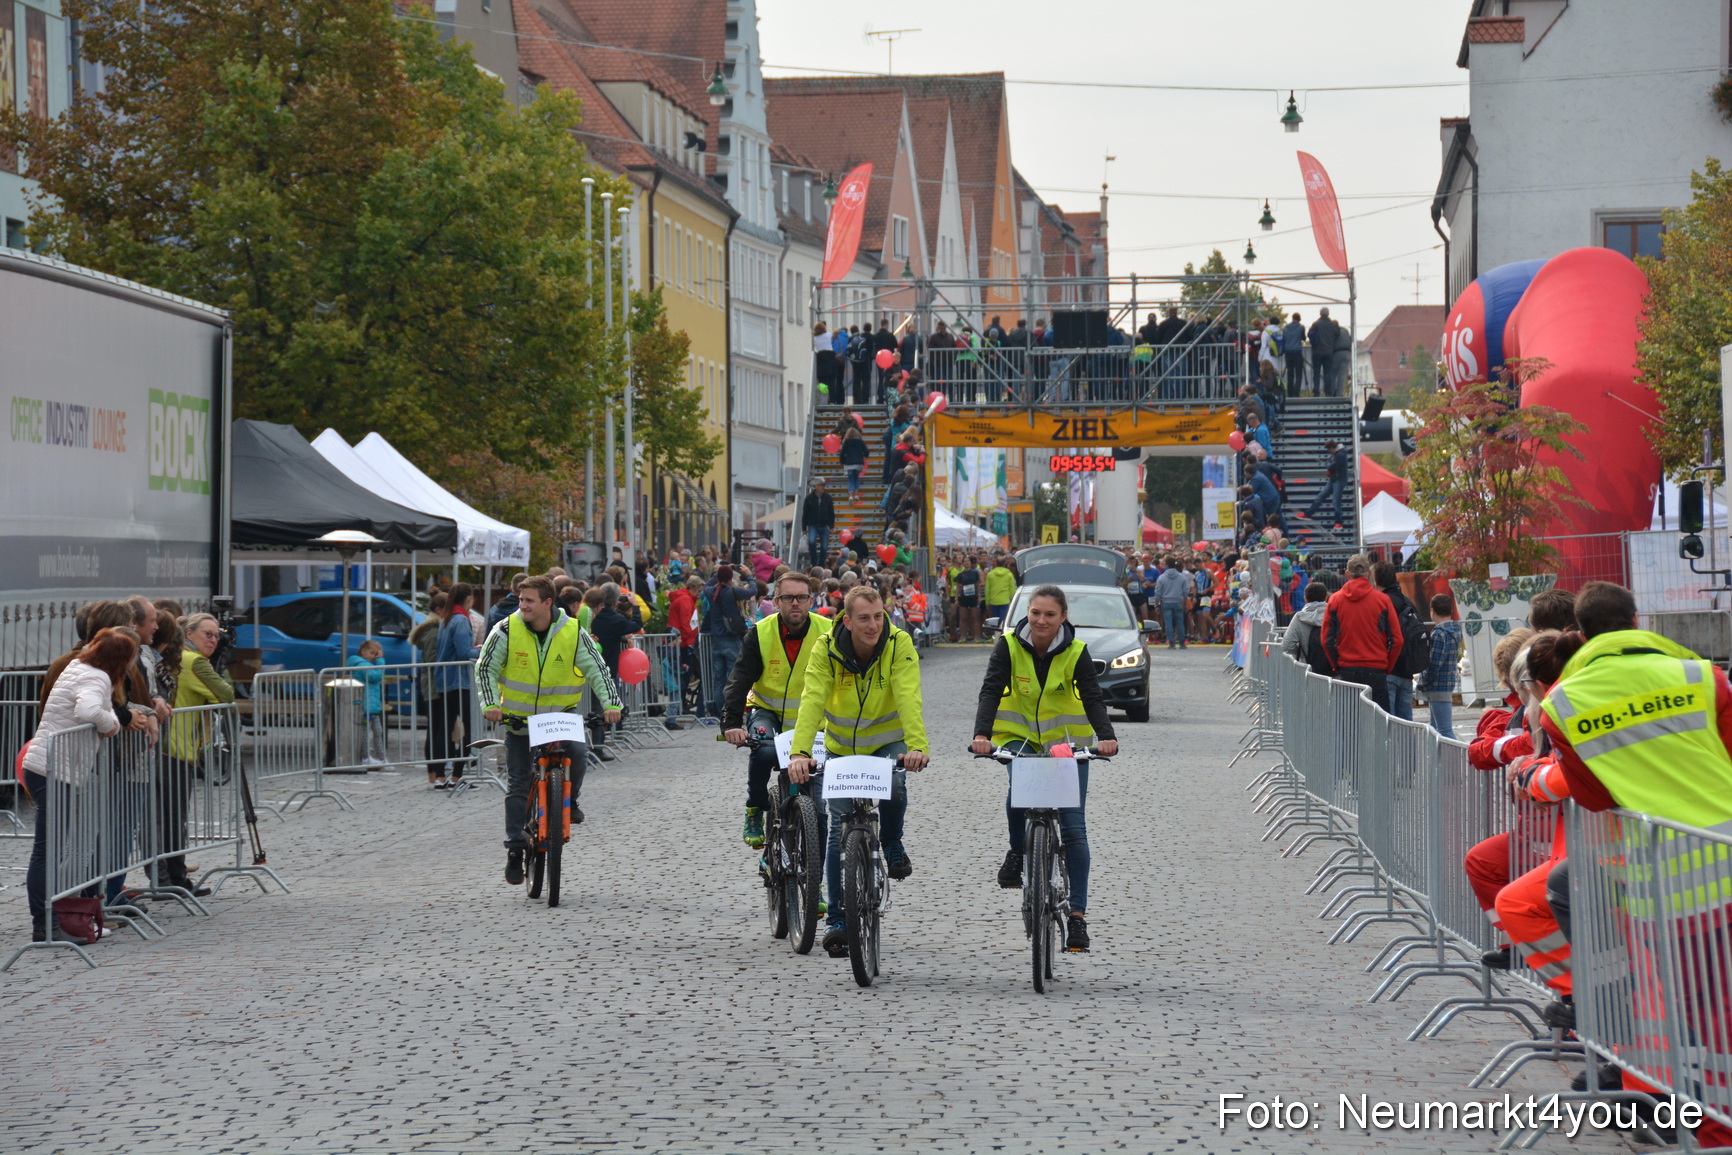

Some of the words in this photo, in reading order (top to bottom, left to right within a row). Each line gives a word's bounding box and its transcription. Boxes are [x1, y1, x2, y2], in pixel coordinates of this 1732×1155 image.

[10, 395, 43, 443] OFFICE
[46, 400, 90, 448] INDUSTRY
[93, 407, 127, 453] LOUNGE
[1051, 418, 1119, 441] ZIEL
[149, 398, 209, 484] BOCK
[1175, 519, 1183, 530] B
[1045, 532, 1054, 544] A
[1577, 693, 1695, 735] Org.-Leiter
[537, 720, 556, 728] Erster
[860, 773, 881, 781] Frau
[827, 784, 888, 792] Halbmarathon
